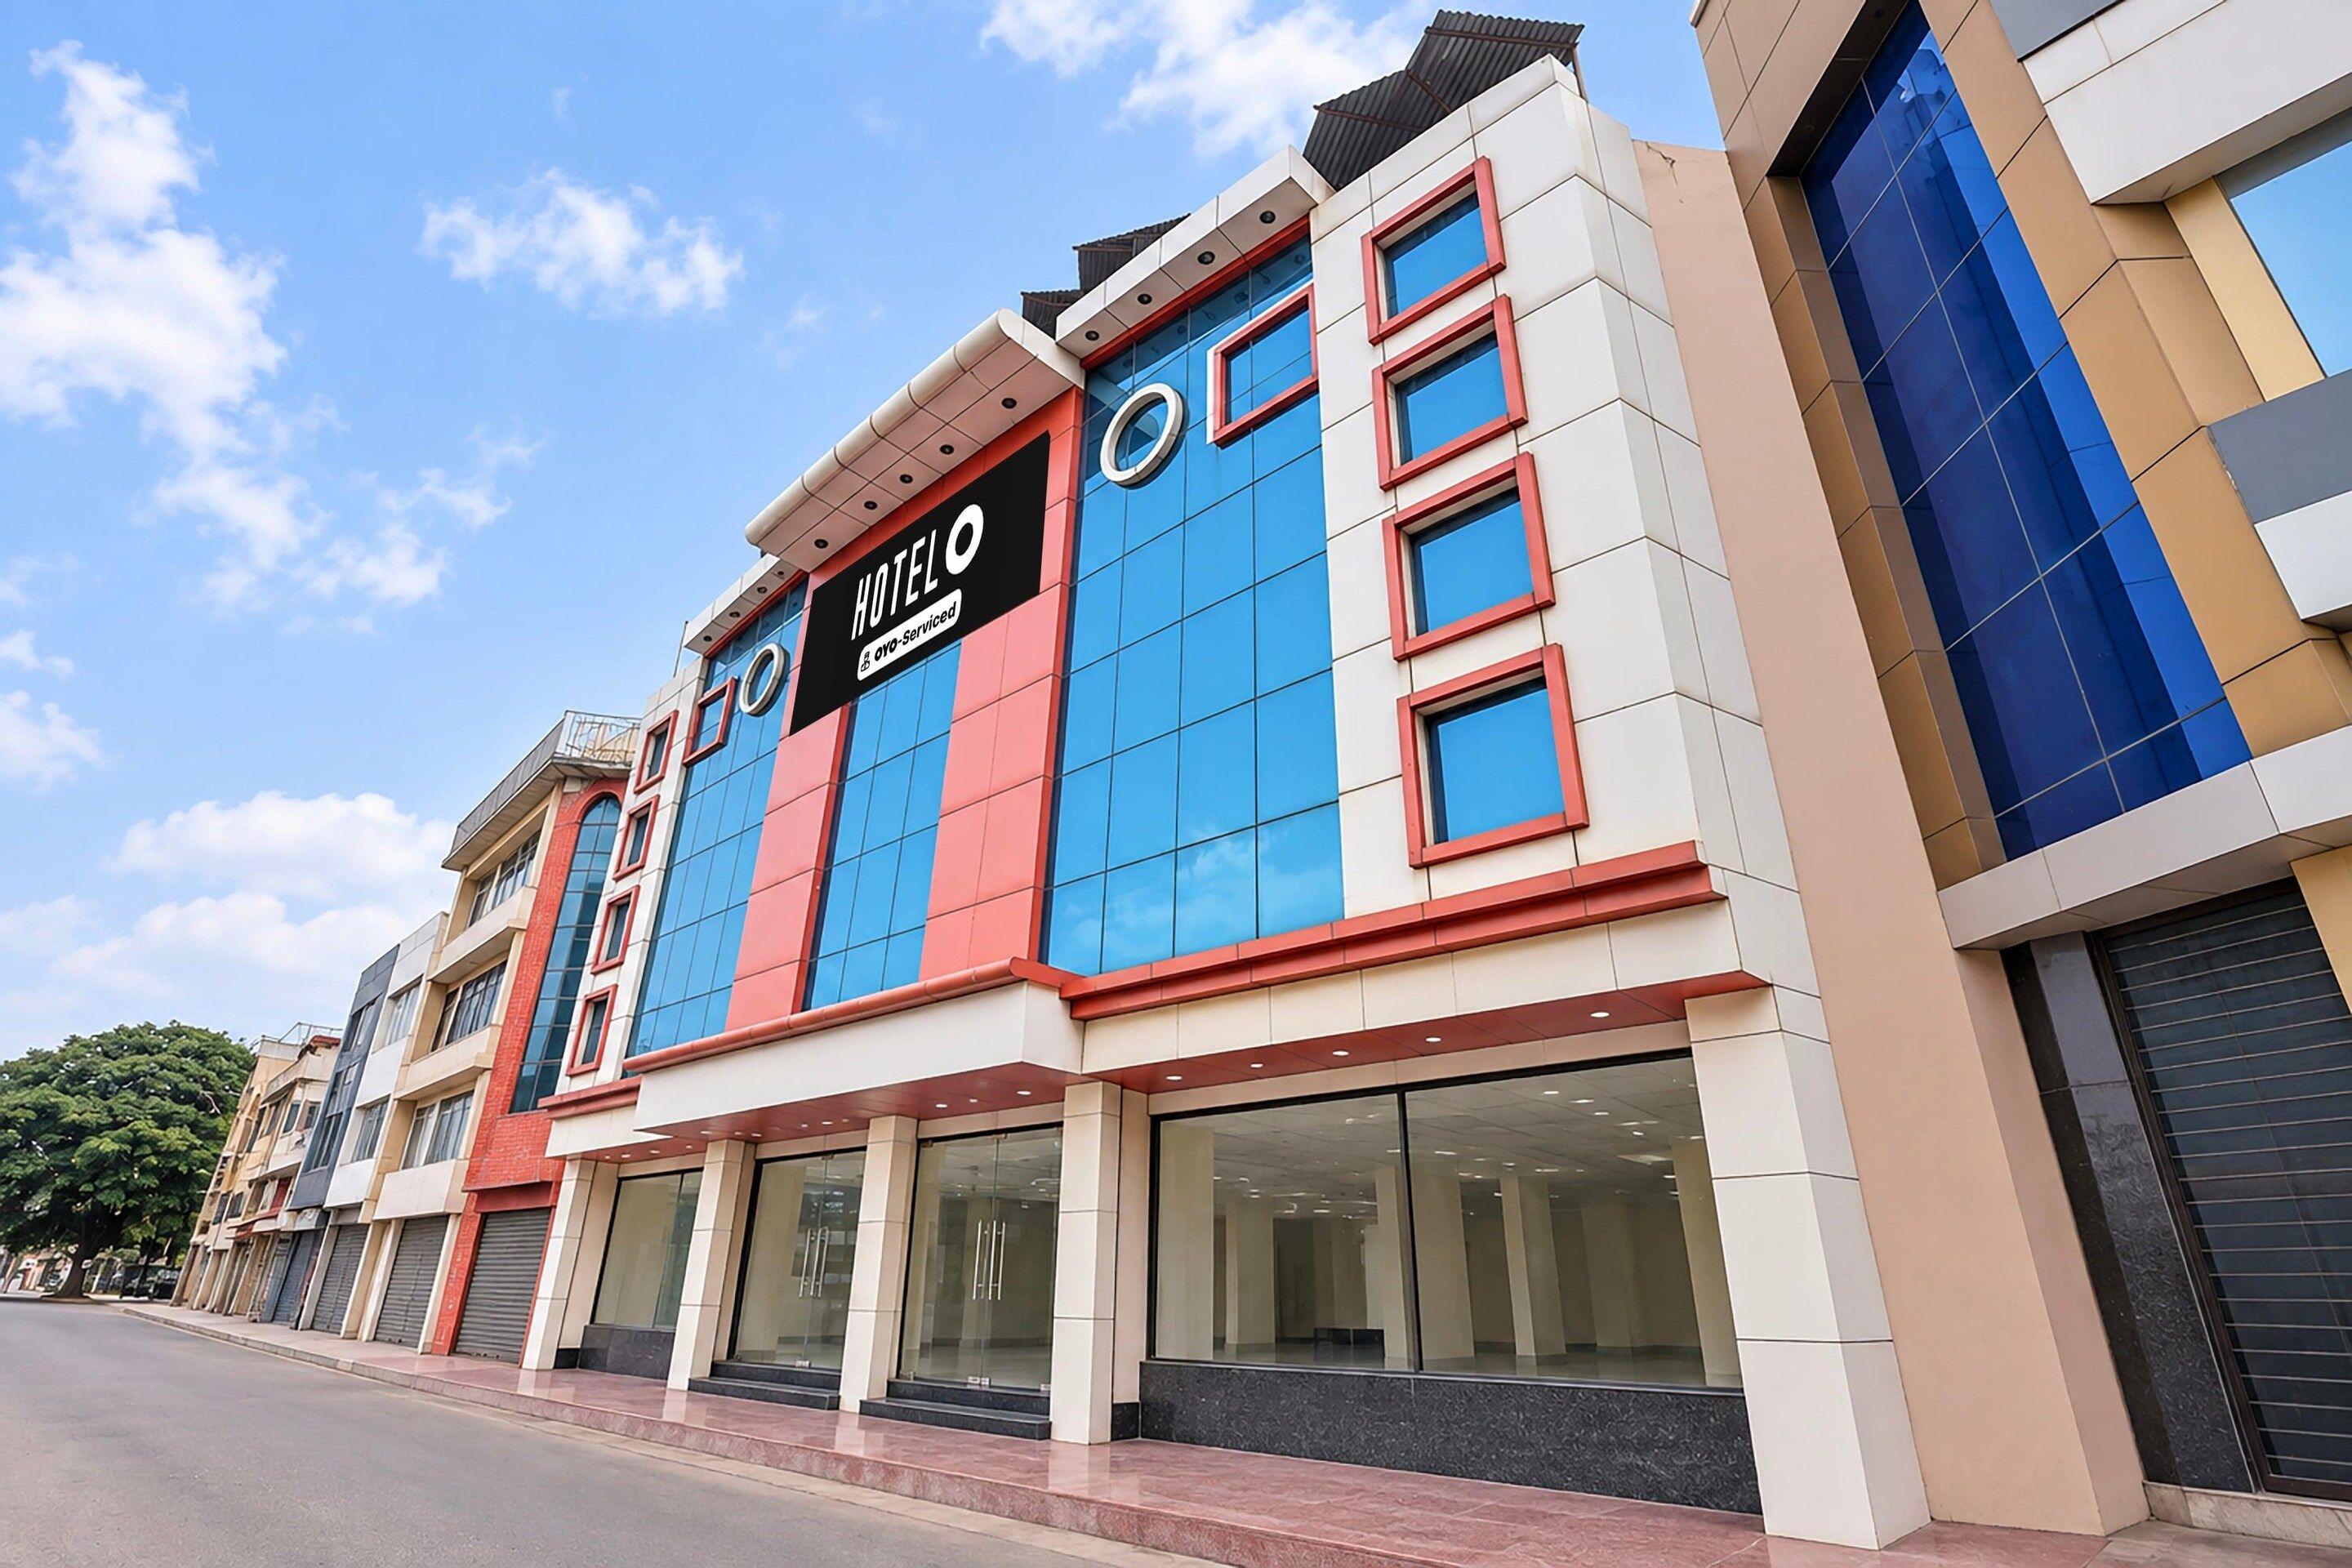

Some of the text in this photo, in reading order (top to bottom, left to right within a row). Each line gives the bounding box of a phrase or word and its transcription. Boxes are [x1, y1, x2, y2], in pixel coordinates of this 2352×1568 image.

[851, 503, 984, 641] HOTEL O
[874, 600, 957, 662] OYO-Serviced
